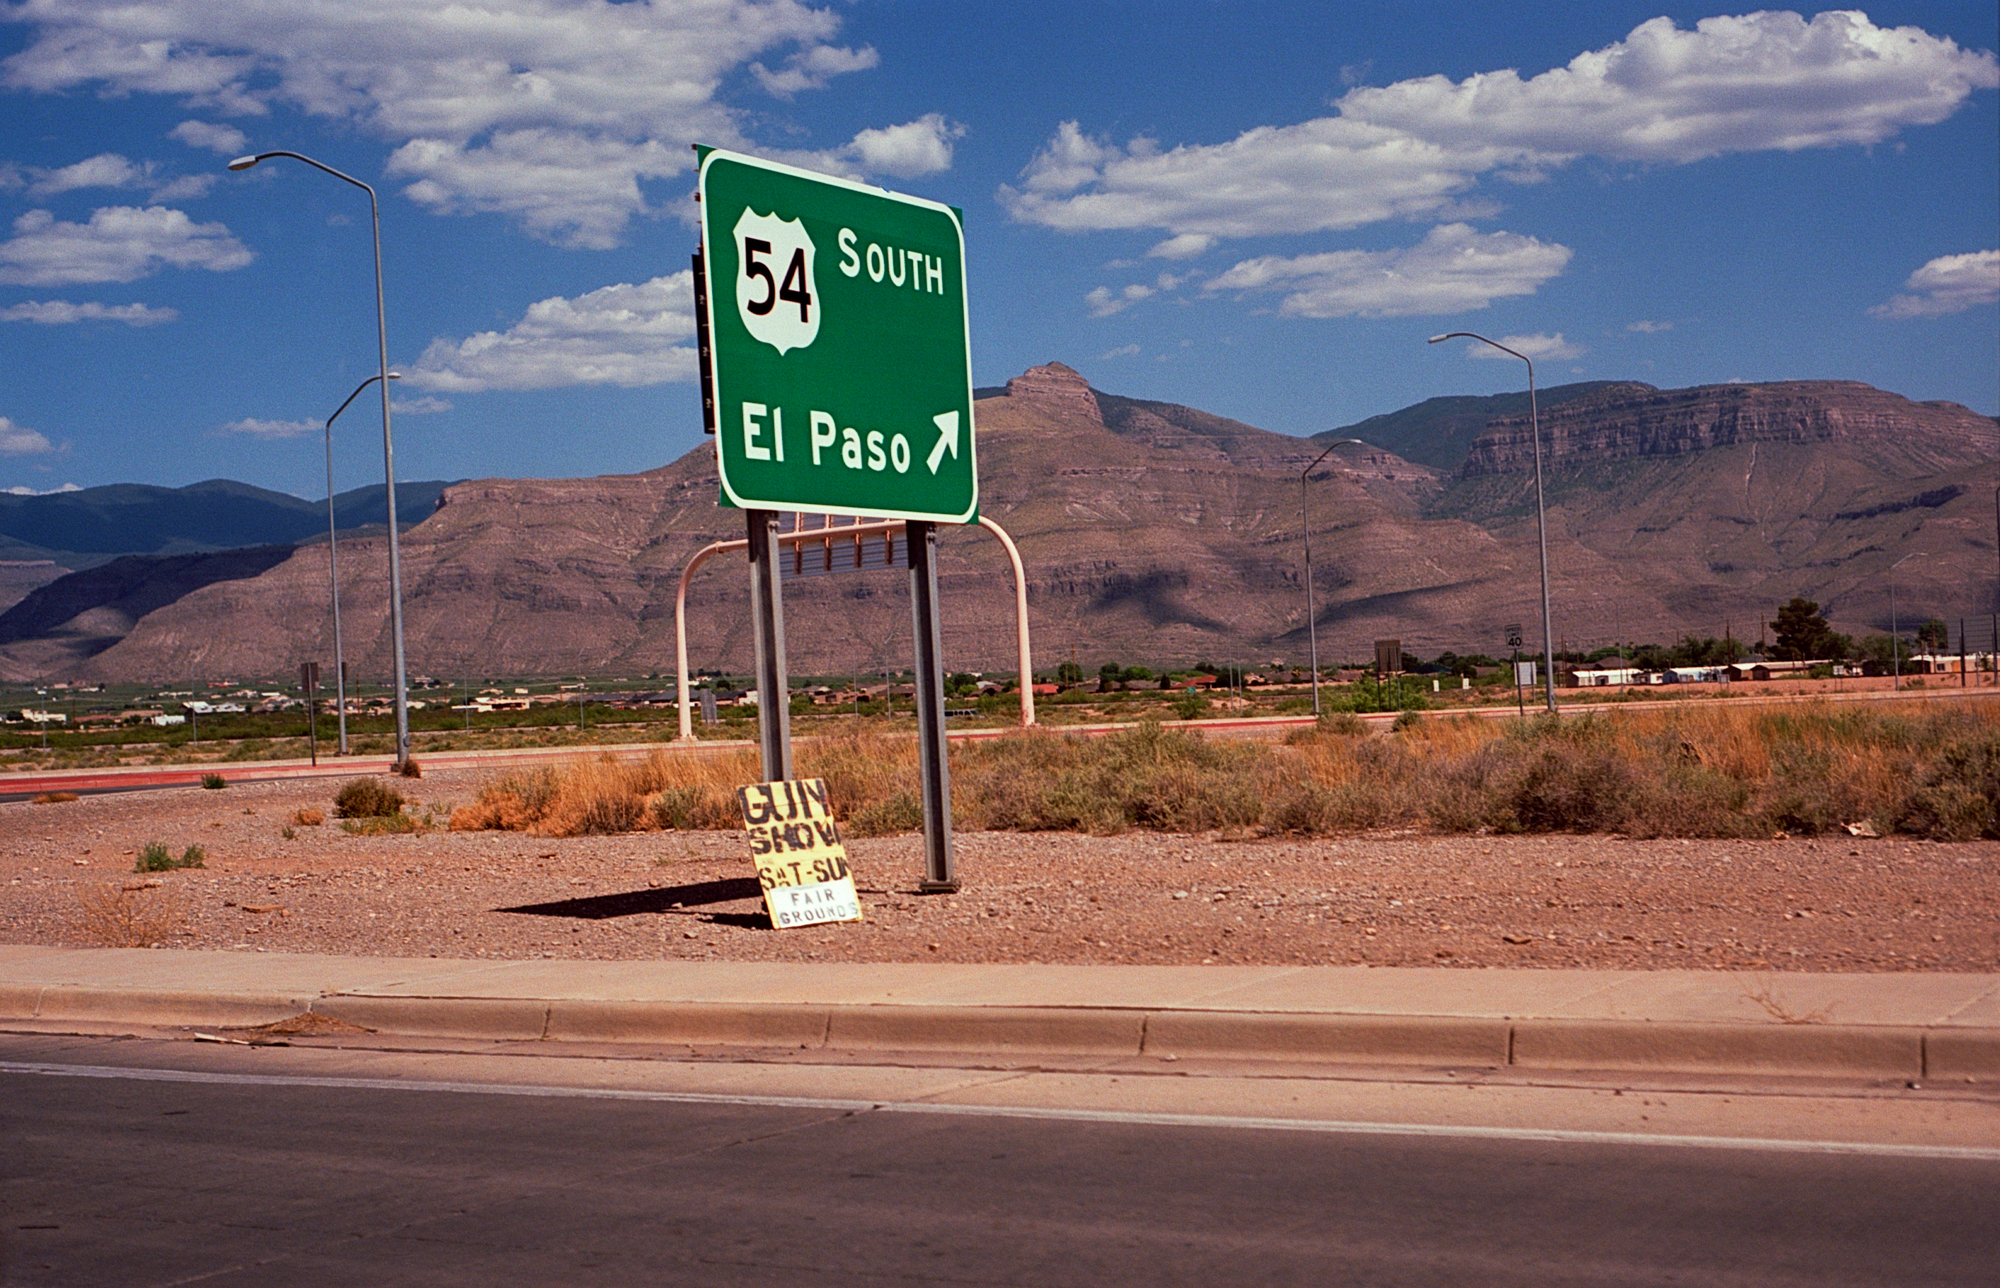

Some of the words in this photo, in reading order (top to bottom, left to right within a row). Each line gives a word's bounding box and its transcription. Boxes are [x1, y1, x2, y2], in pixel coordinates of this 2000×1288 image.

[745, 236, 811, 323] 54
[838, 228, 944, 295] SOUTH
[742, 402, 785, 462] El
[810, 410, 911, 474] Paso
[1508, 637, 1522, 647] 40
[738, 779, 831, 825] GUN
[749, 821, 841, 855] SHOW
[780, 902, 859, 925] GROUNDS
[791, 889, 834, 906] FAIR
